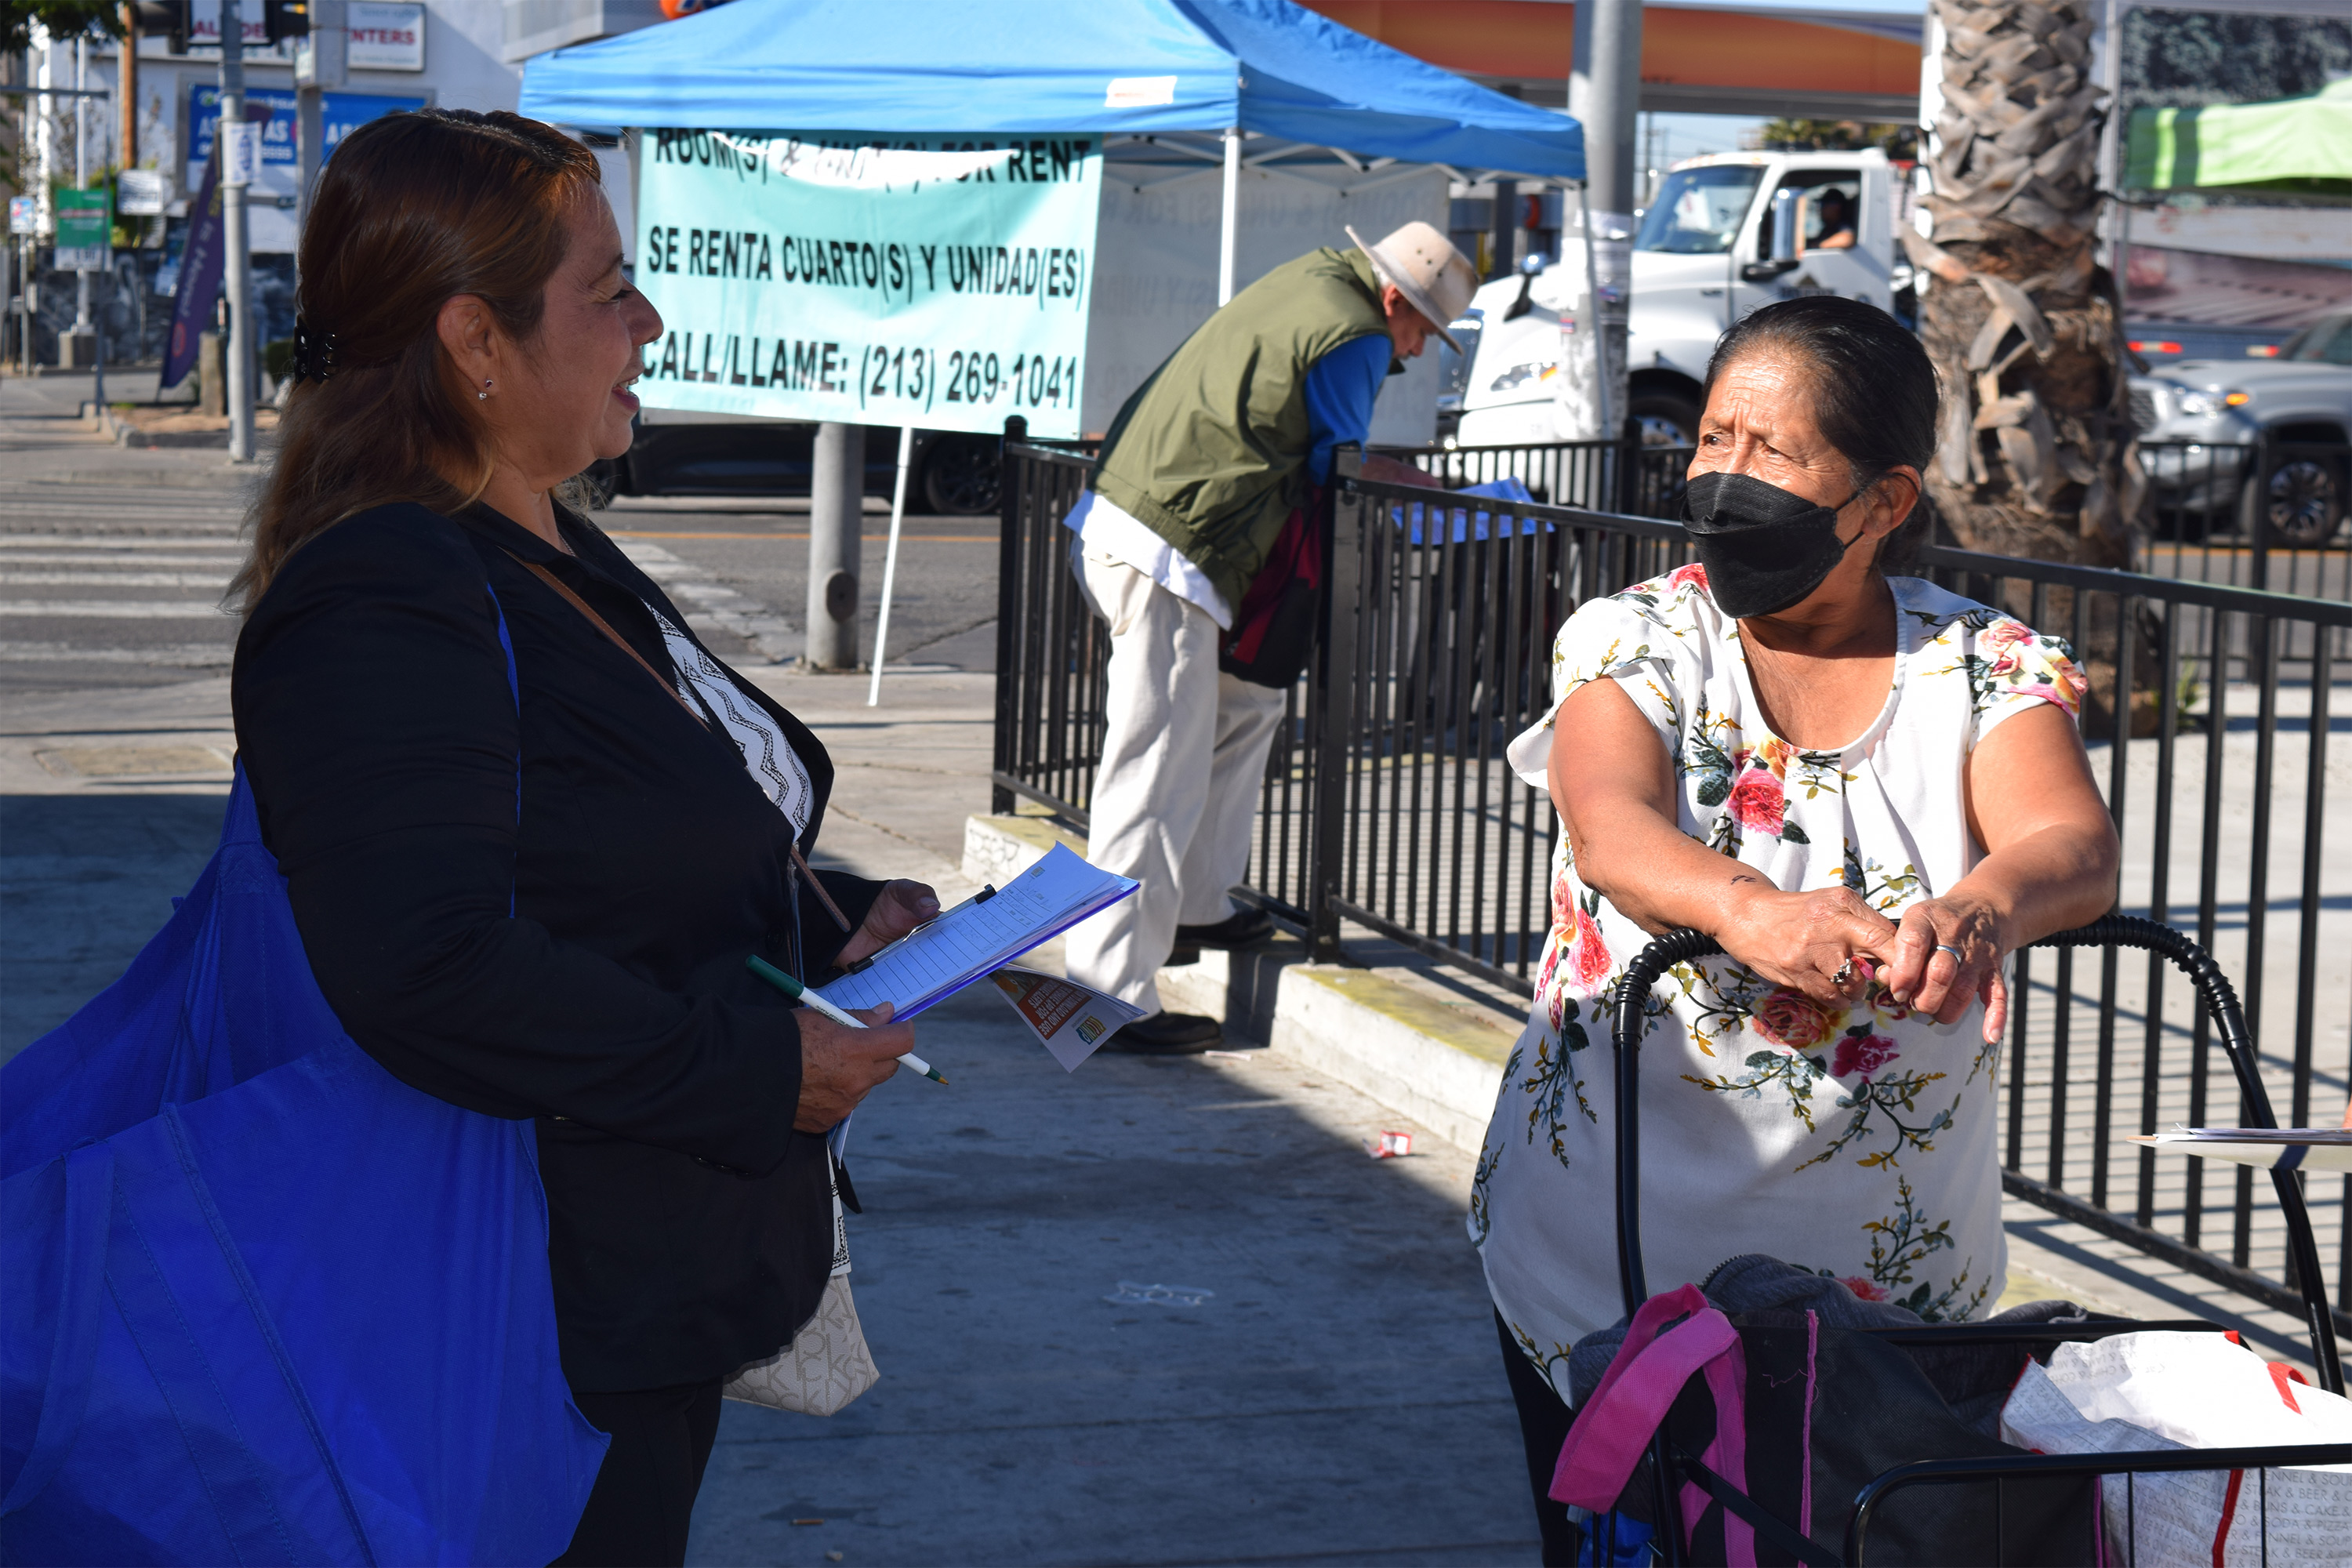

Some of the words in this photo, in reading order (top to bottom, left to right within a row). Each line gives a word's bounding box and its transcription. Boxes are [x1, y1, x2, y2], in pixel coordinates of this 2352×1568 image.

[656, 128, 768, 185] ROOM(S)
[1009, 140, 1091, 183] RENT
[648, 225, 680, 274] SE
[689, 227, 772, 281] RENTA
[782, 234, 913, 304] CUARTO(S)
[919, 244, 936, 292] Y
[948, 245, 1085, 311] UNIDAD(ES)
[643, 328, 848, 394] CALL/LLAME:
[859, 343, 935, 413] (213)
[946, 350, 1077, 409] 269-1041
[1035, 1005, 1049, 1020] FOR
[1047, 1011, 1062, 1026] AND
[1038, 1020, 1054, 1036] USE
[2245, 1484, 2281, 1497] STAK
[2255, 1530, 2301, 1544] FNNEL
